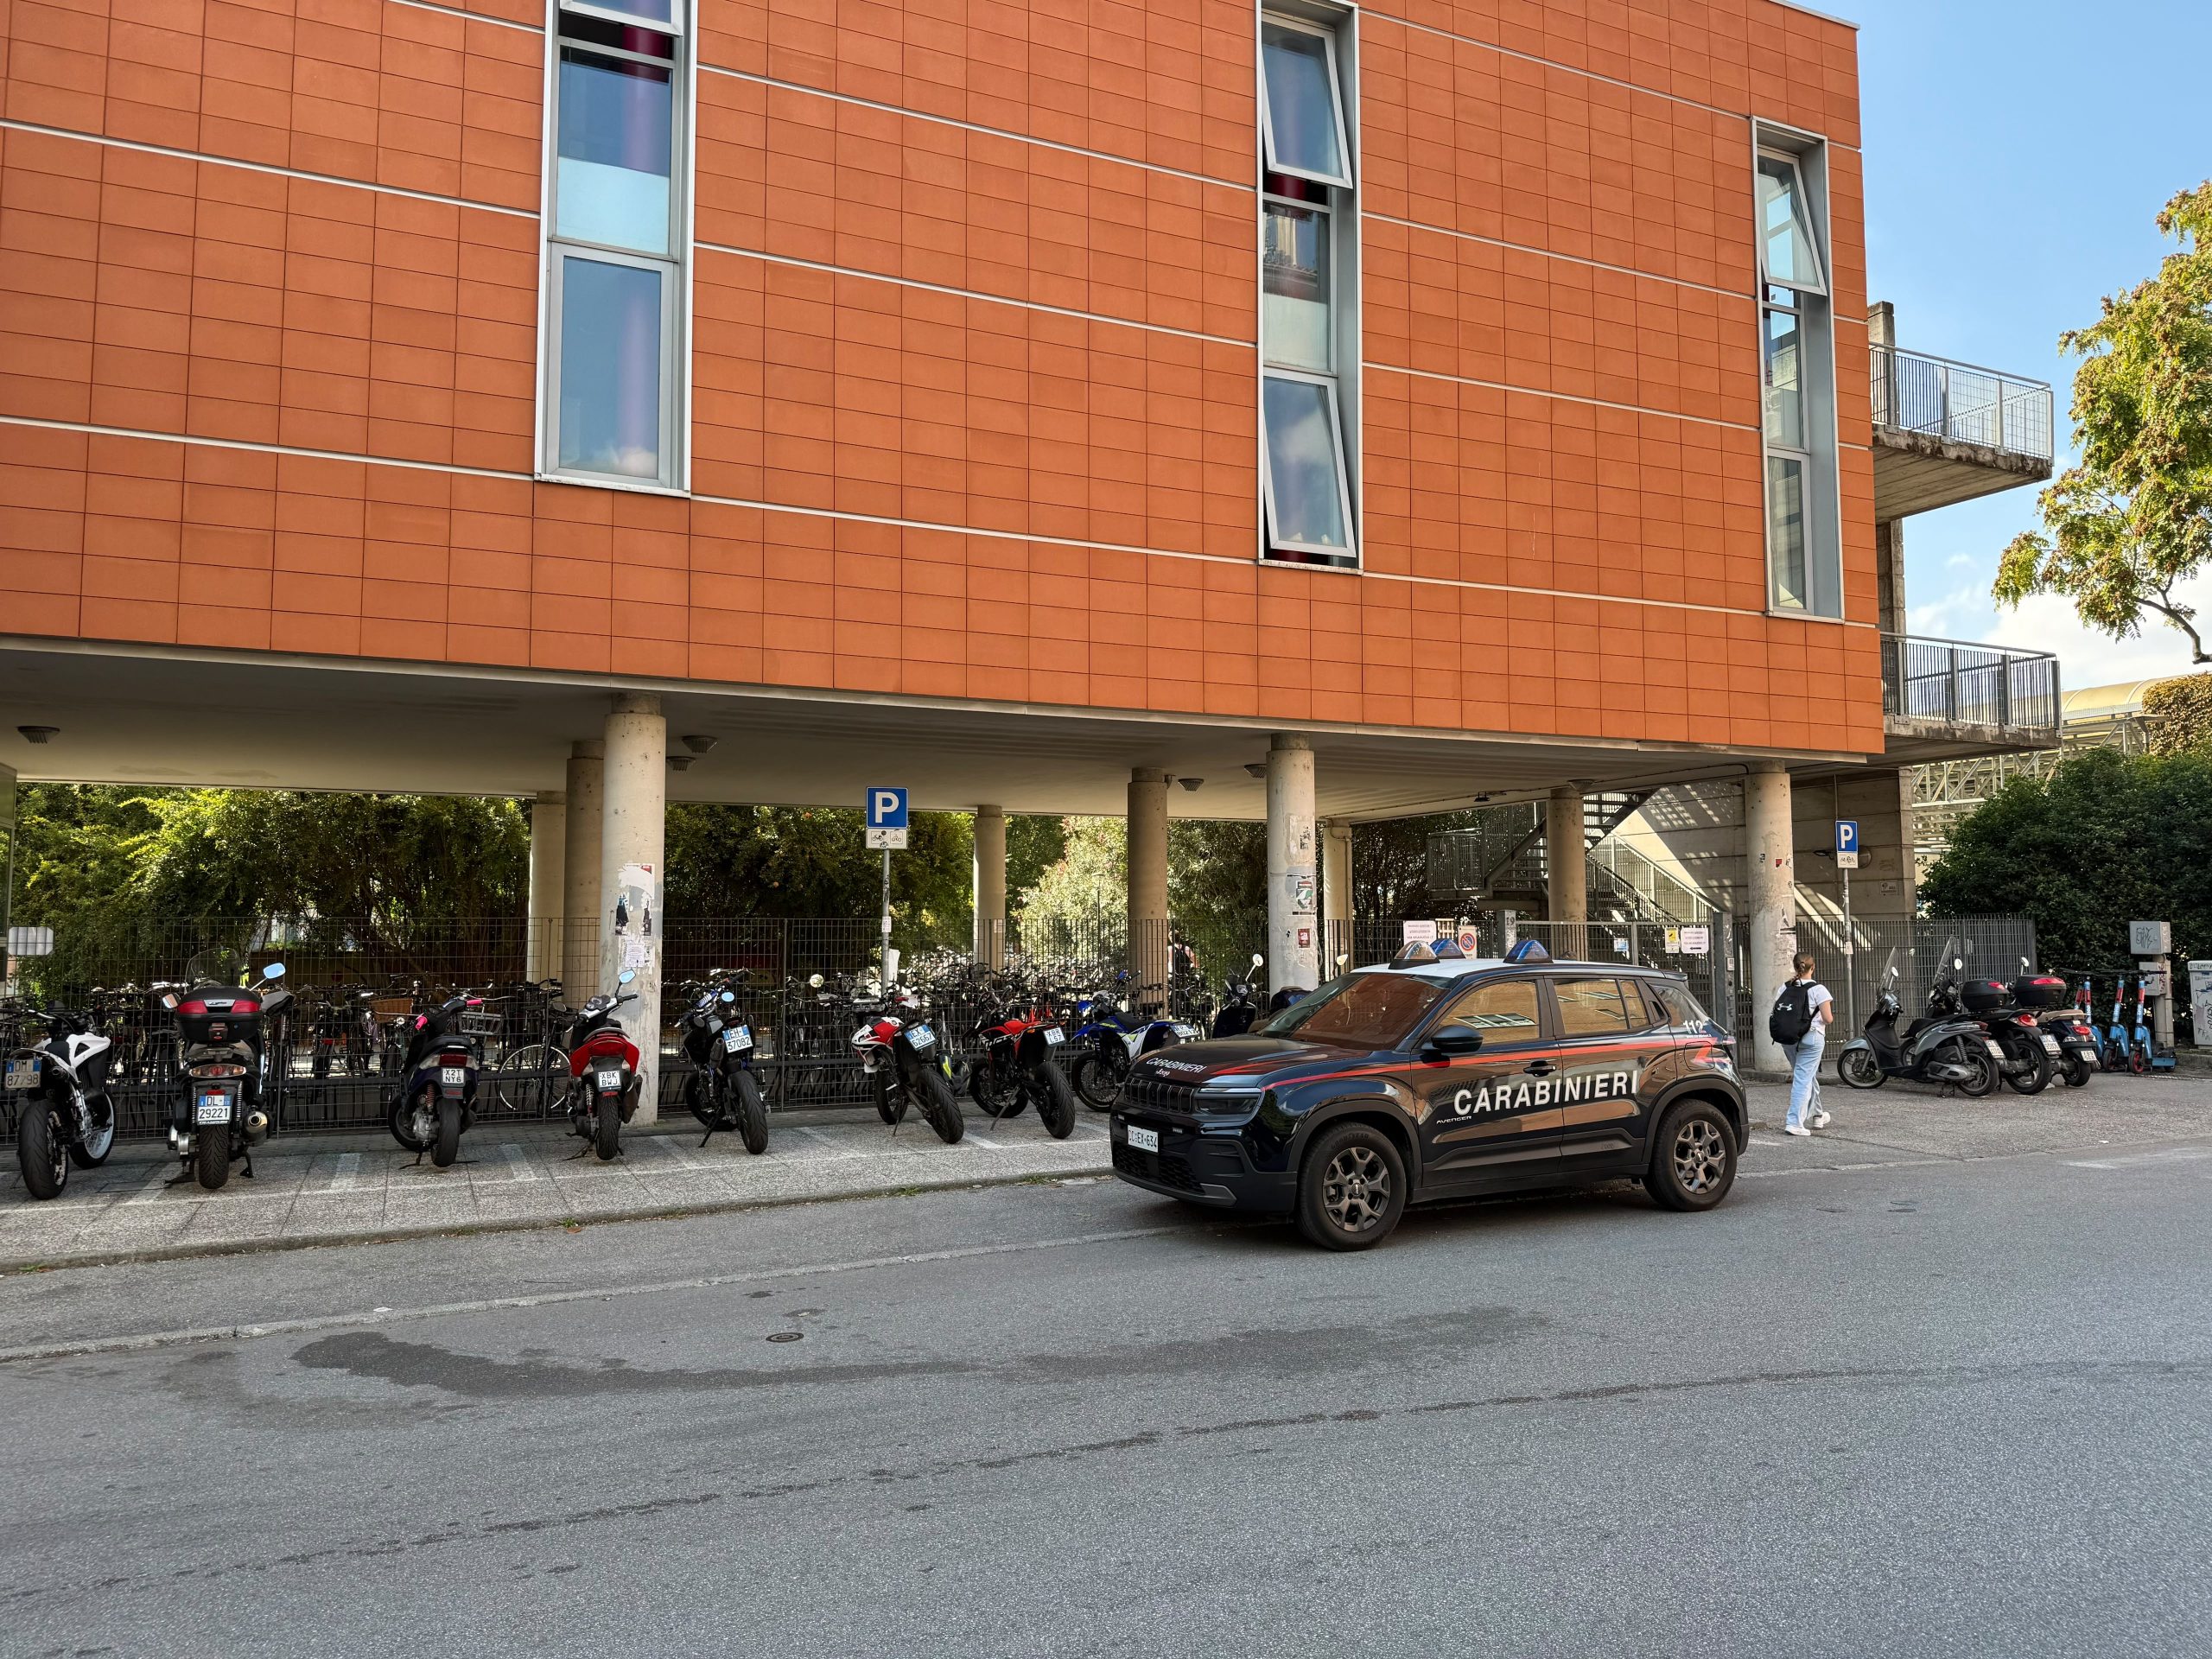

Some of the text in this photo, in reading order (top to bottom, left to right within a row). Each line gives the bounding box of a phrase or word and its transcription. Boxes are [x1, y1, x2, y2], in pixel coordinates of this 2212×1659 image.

[875, 791, 899, 823] P
[1840, 824, 1853, 849] P
[911, 1027, 920, 1038] EX
[1682, 1020, 1707, 1034] 112
[727, 1036, 751, 1050] 37082
[1146, 1057, 1208, 1073] CARABINIERI
[7, 1074, 39, 1086] 87798
[1453, 1070, 1638, 1116] CARABINIERI
[207, 1096, 219, 1106] DL
[199, 1108, 228, 1120] 29221
[1436, 1116, 1472, 1124] AVENGER
